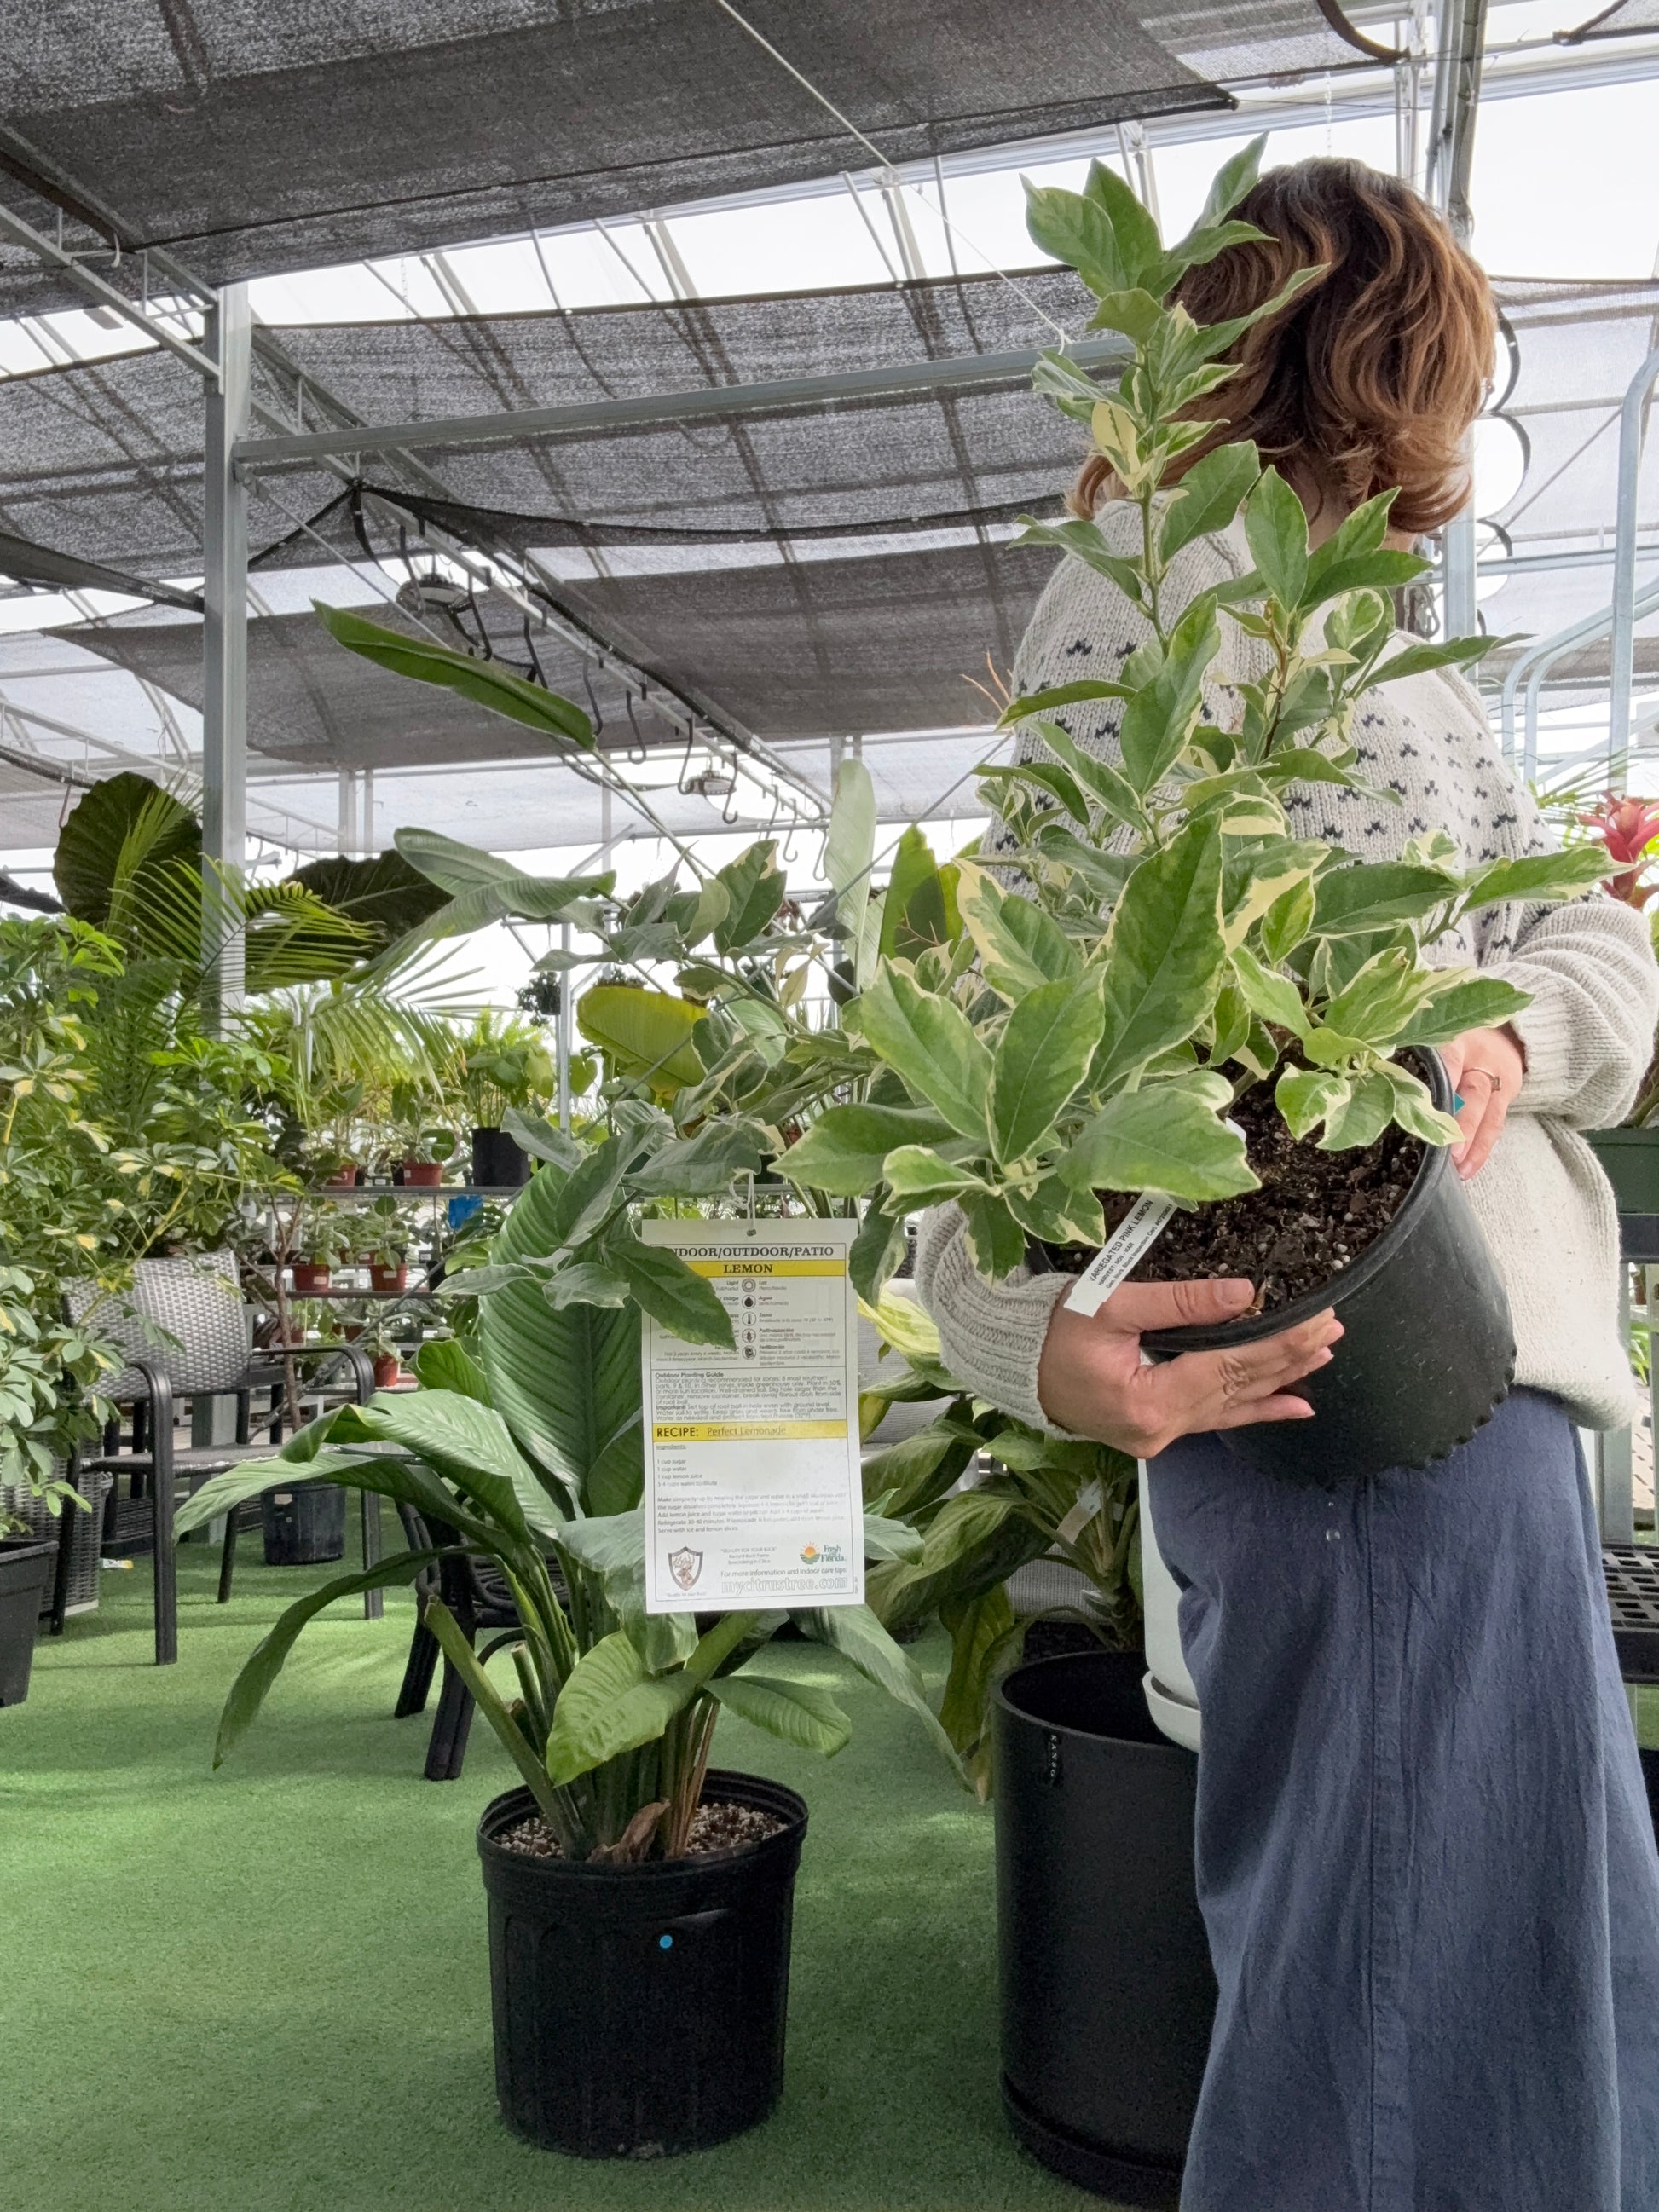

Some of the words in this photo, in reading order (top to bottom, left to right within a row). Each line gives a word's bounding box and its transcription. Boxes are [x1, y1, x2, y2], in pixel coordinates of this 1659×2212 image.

[1120, 1225, 1135, 1243] PINK
[1135, 1199, 1153, 1226] LEMON
[673, 1247, 834, 1258] DOOR/OUTDOOR/PATIO
[723, 1264, 773, 1273] LEMON
[656, 1427, 699, 1438] RECIPE:
[707, 1426, 737, 1437] Perfect
[740, 1425, 786, 1435] Lemonade
[824, 1544, 841, 1552] Fresh
[721, 1577, 848, 1596] mycitrustree.com
